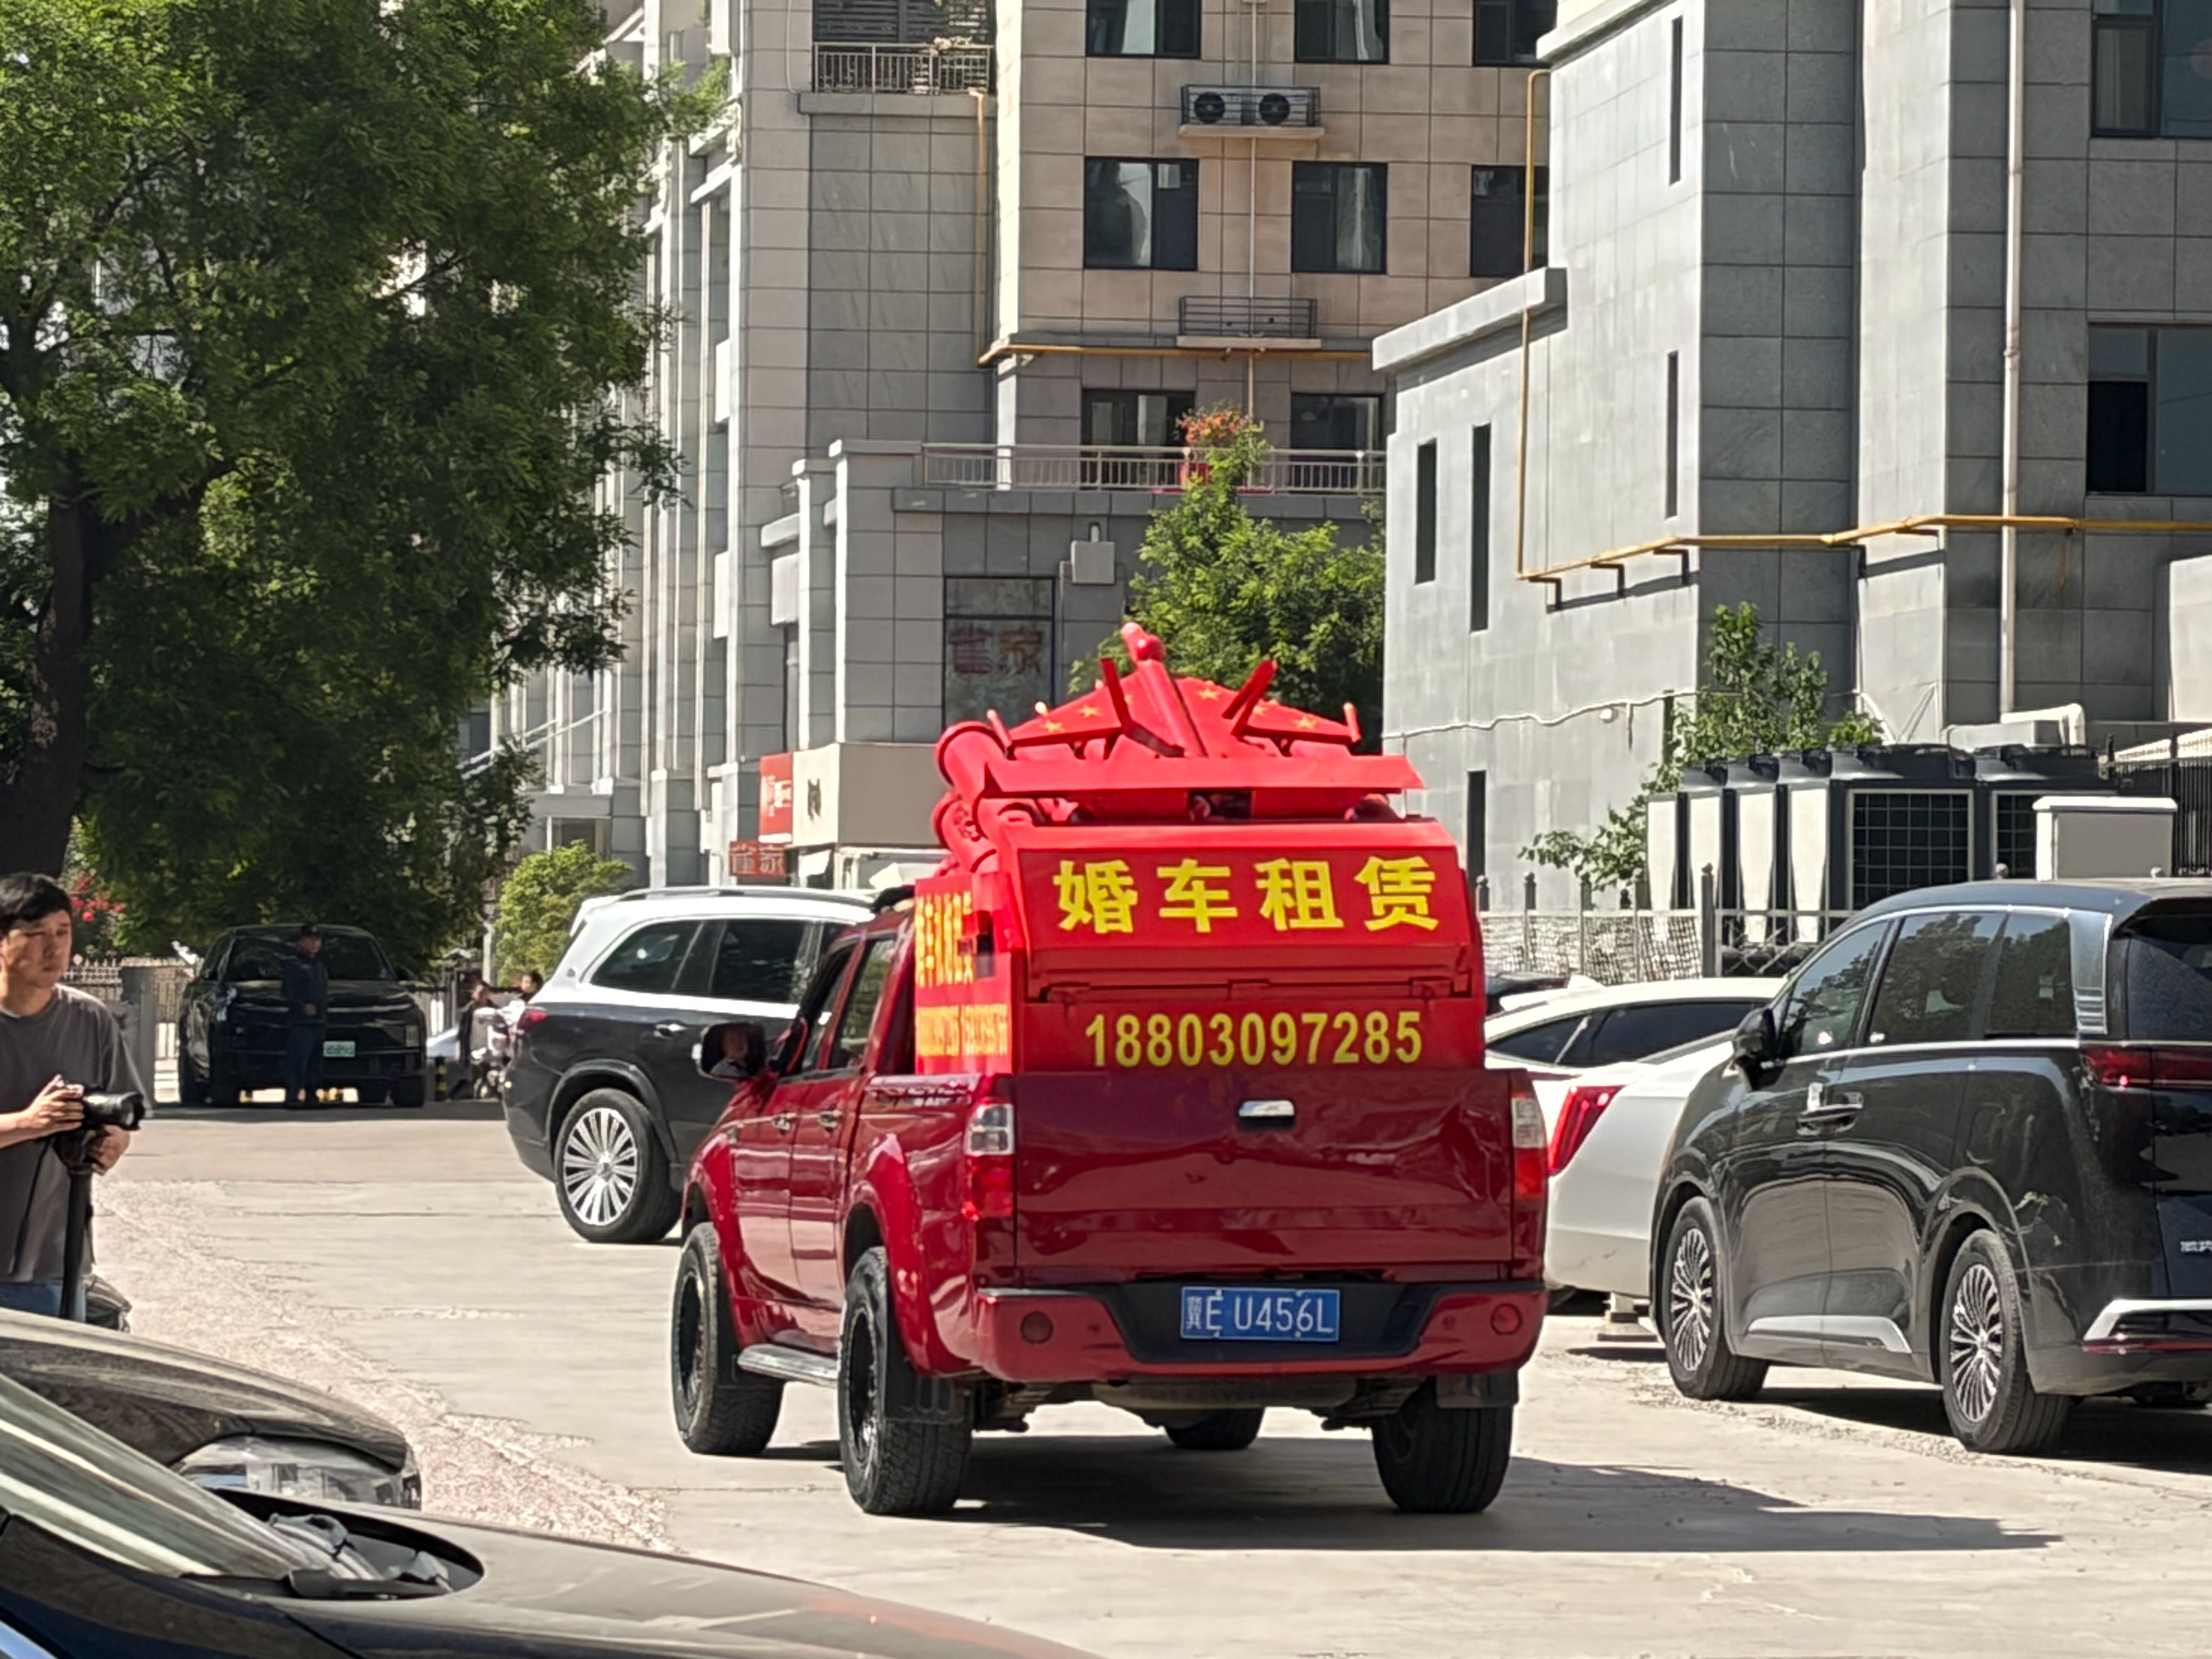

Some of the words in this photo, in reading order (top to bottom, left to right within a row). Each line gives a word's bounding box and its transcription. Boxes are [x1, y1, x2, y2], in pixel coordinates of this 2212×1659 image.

[1053, 856, 1440, 933] 婚车租赁
[1085, 1011, 1422, 1067] 18803097285
